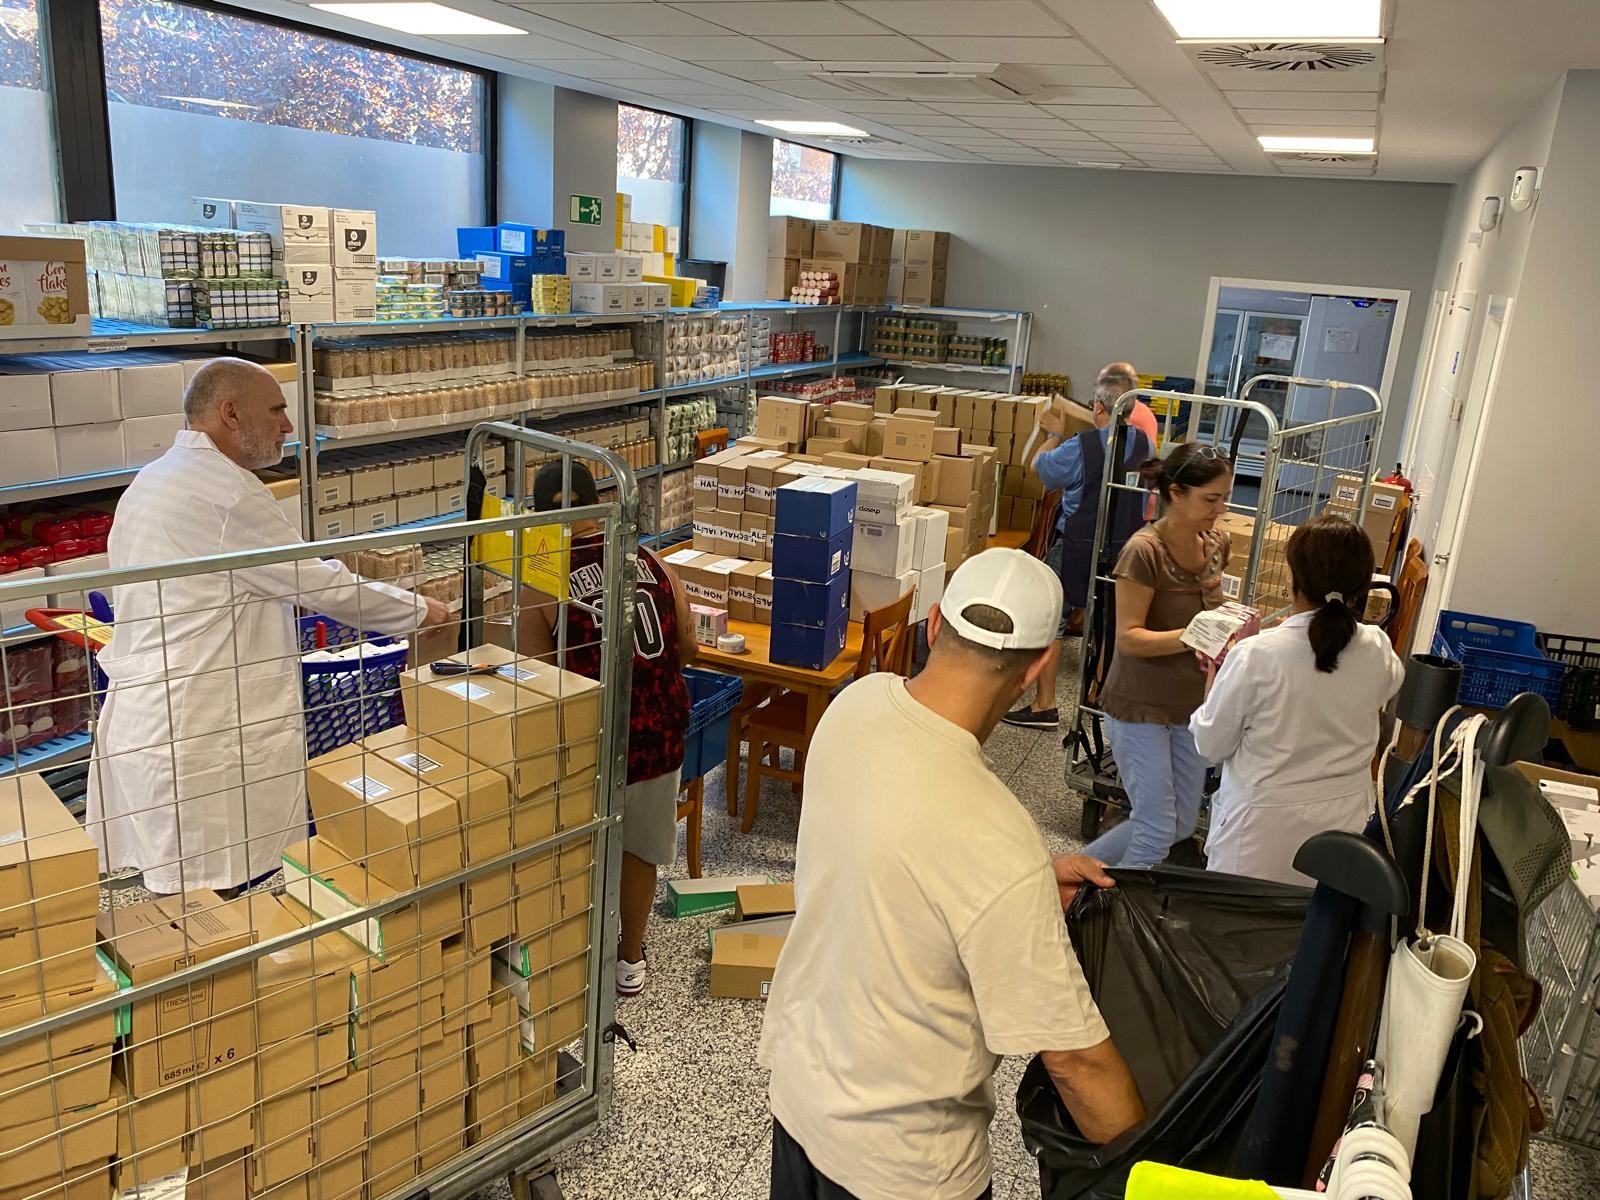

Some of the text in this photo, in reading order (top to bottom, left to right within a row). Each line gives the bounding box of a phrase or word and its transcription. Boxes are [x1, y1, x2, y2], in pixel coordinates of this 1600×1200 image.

[38, 274, 68, 293] flake
[226, 1047, 235, 1060] 6
[164, 1069, 181, 1081] 685
